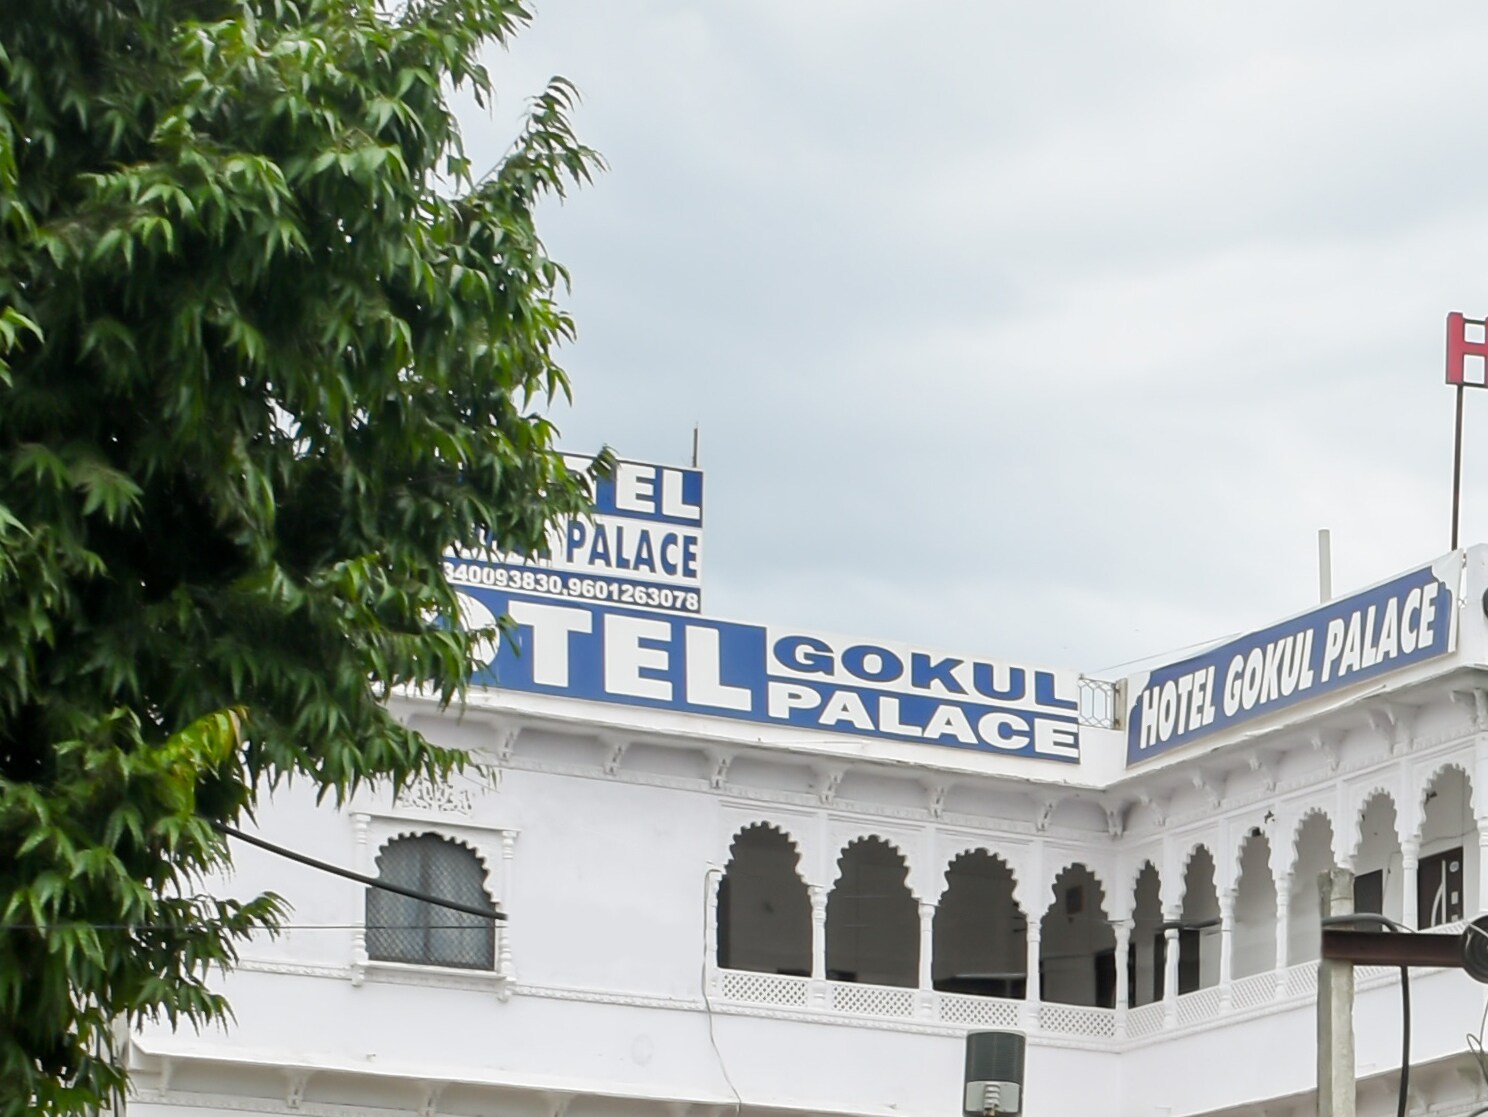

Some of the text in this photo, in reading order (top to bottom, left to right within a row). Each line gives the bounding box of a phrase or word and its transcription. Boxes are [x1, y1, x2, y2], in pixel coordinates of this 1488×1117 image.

[566, 516, 698, 579] PALACE
[773, 635, 1078, 711] GOKUL
[1140, 581, 1439, 750] HOTEL GOKUL PALACE
[768, 681, 1080, 758] PALACE
